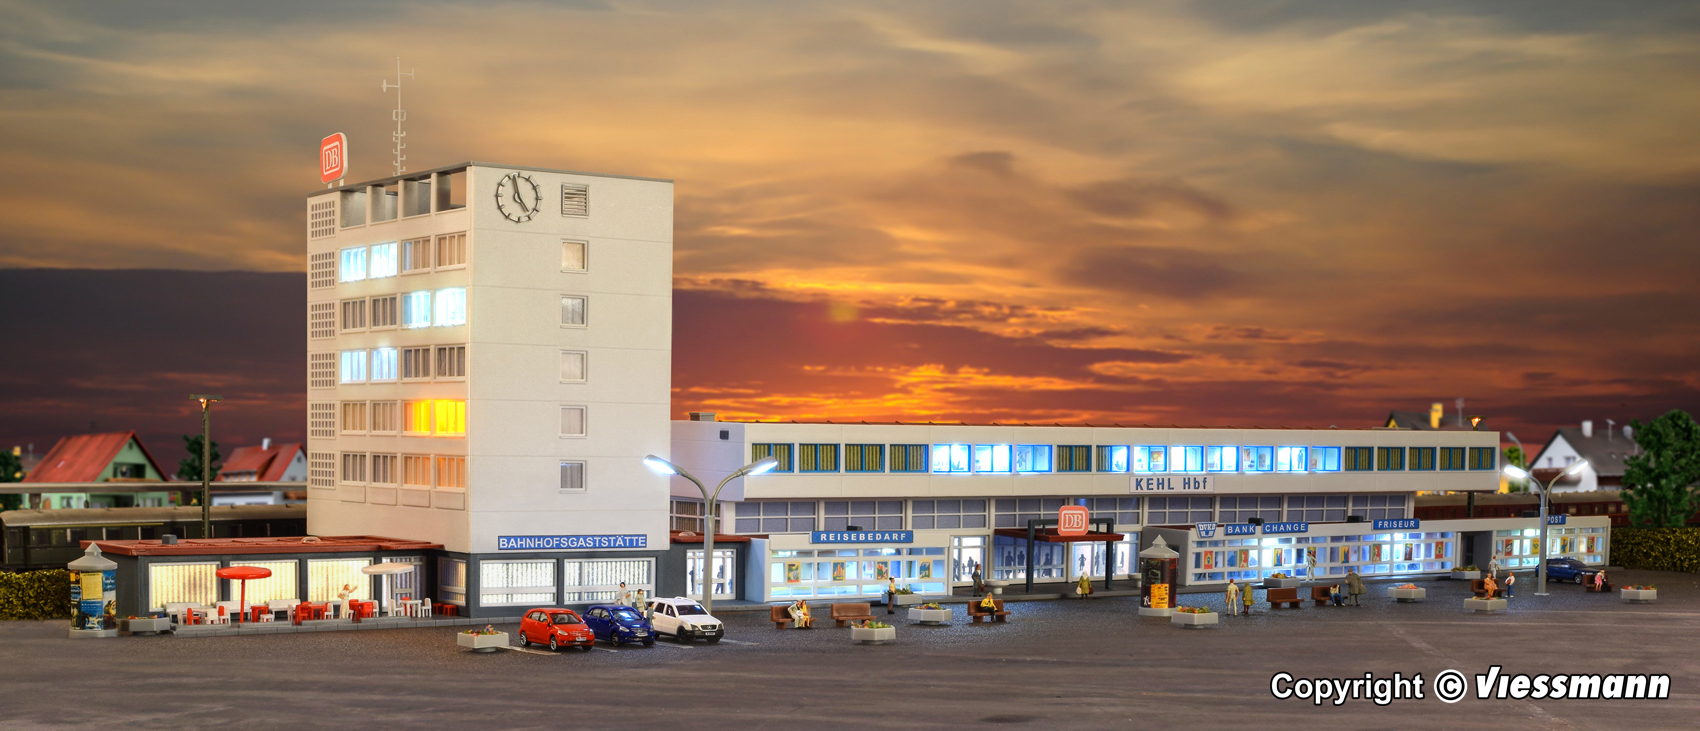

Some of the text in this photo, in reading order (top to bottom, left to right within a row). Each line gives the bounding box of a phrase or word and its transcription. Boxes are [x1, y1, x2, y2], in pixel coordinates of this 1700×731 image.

[325, 148, 339, 170] DB
[1135, 477, 1207, 491] KEHL Hbf
[1064, 514, 1082, 528] DB
[1378, 520, 1415, 528] FRISEUR
[1227, 523, 1306, 534] BANK CHANGE
[499, 536, 646, 548] BAHNHOFSGASTSTÄTTE
[820, 533, 906, 541] REISEBEDARF
